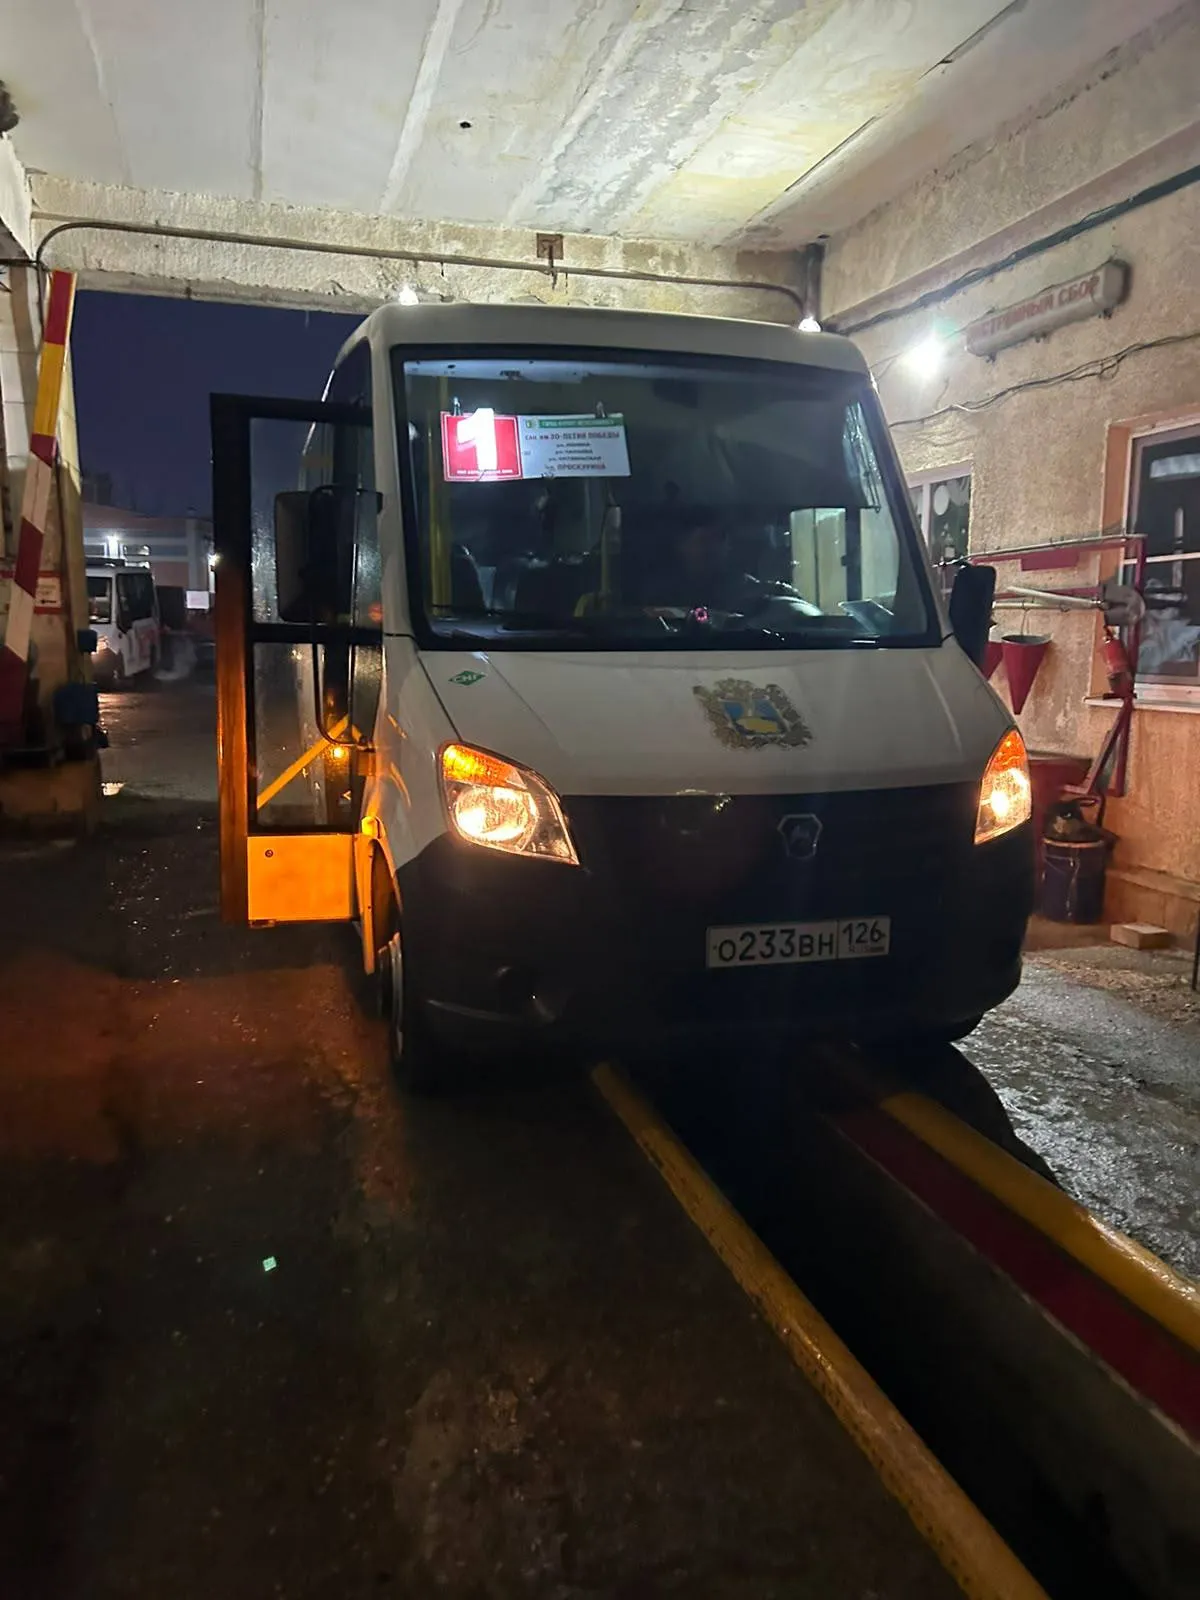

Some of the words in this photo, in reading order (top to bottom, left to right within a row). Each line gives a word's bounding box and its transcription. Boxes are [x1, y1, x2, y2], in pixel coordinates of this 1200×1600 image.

[457, 408, 497, 471] 1
[718, 929, 834, 962] О233ВН
[842, 920, 884, 943] 126
